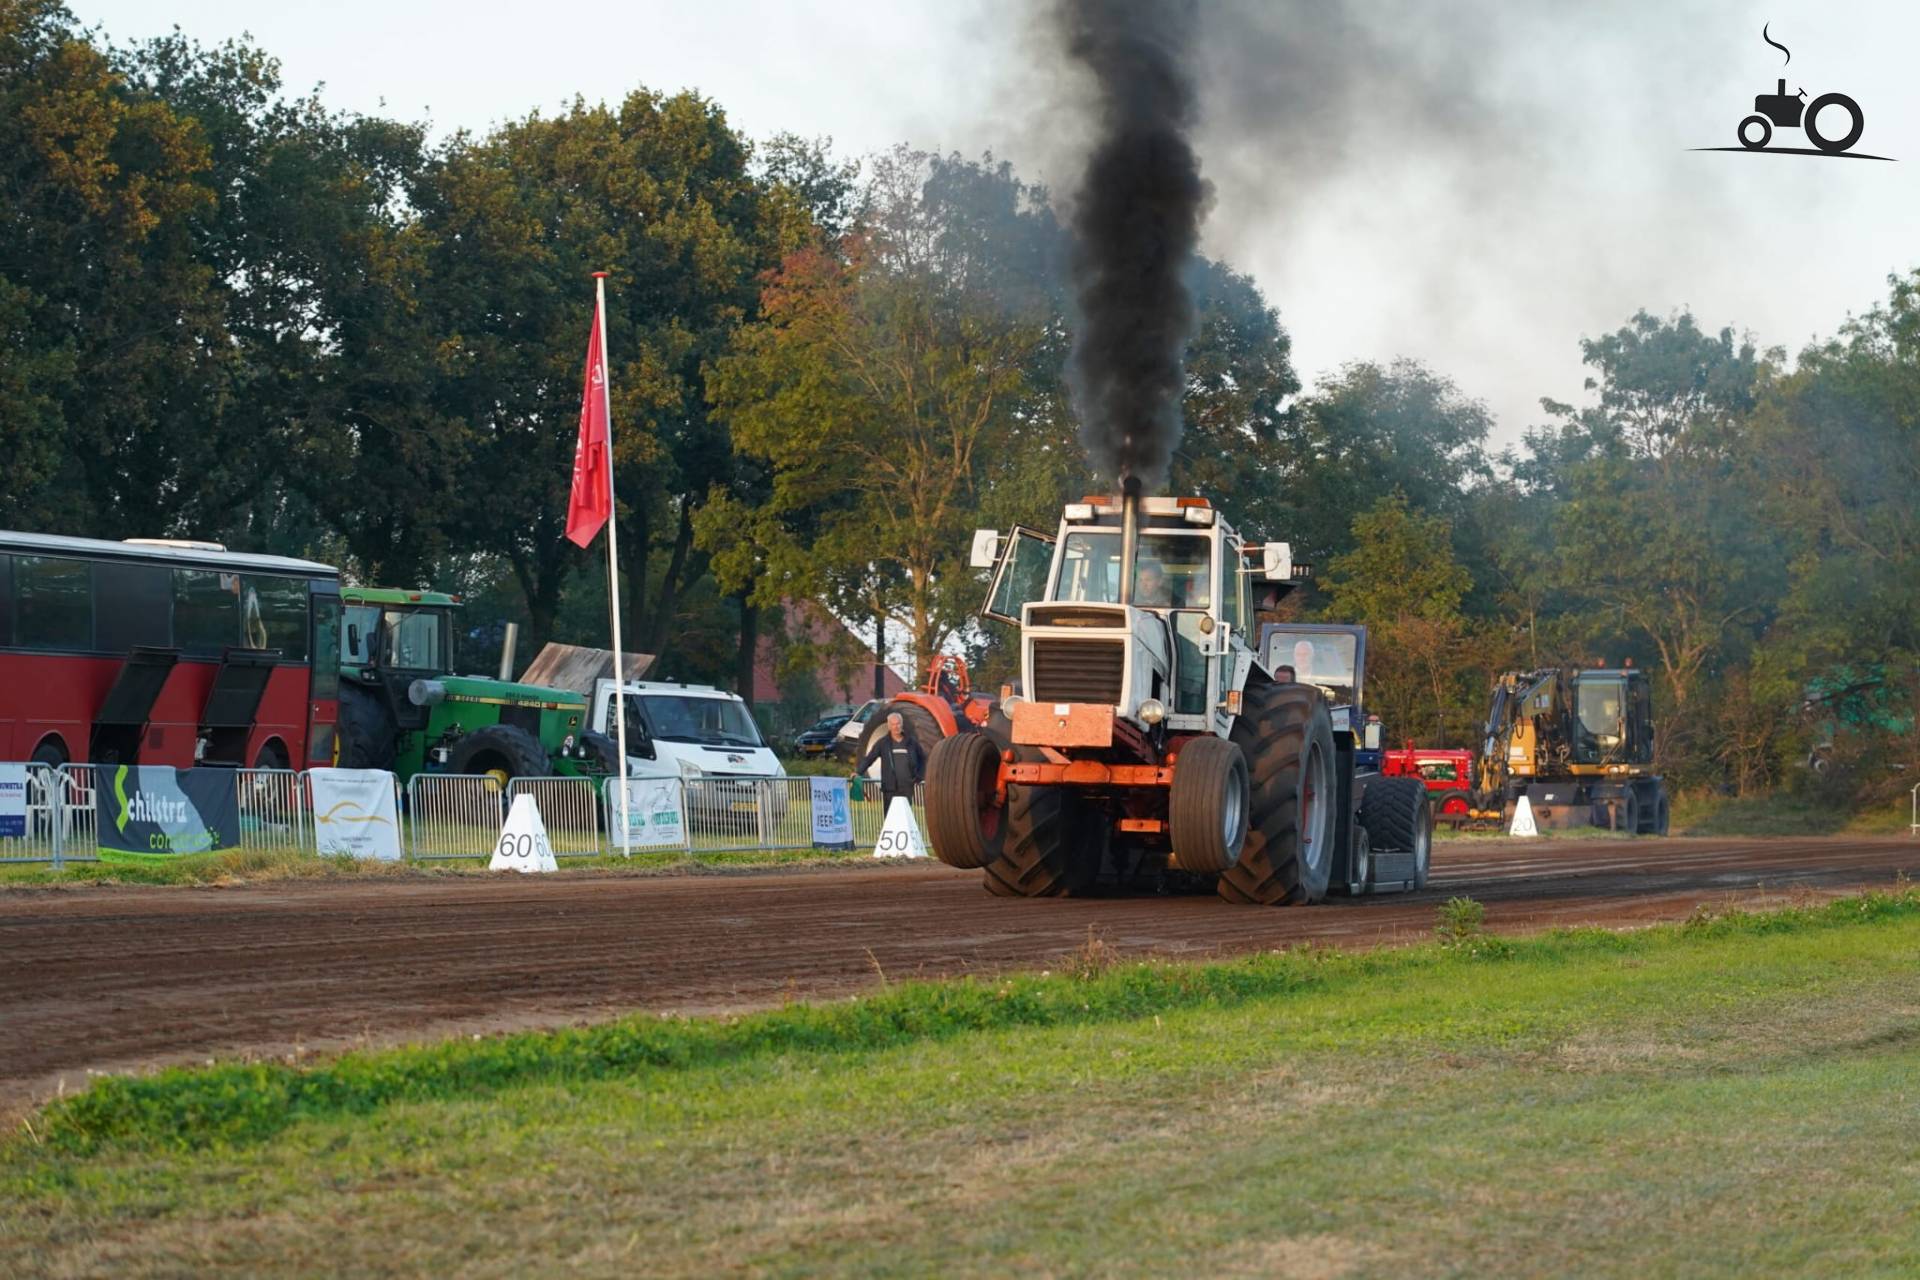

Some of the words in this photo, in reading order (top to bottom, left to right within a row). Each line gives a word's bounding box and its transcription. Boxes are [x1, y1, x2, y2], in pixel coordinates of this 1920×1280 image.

[114, 765, 188, 834] Schilstra
[500, 833, 532, 858] 60
[880, 830, 908, 851] 50
